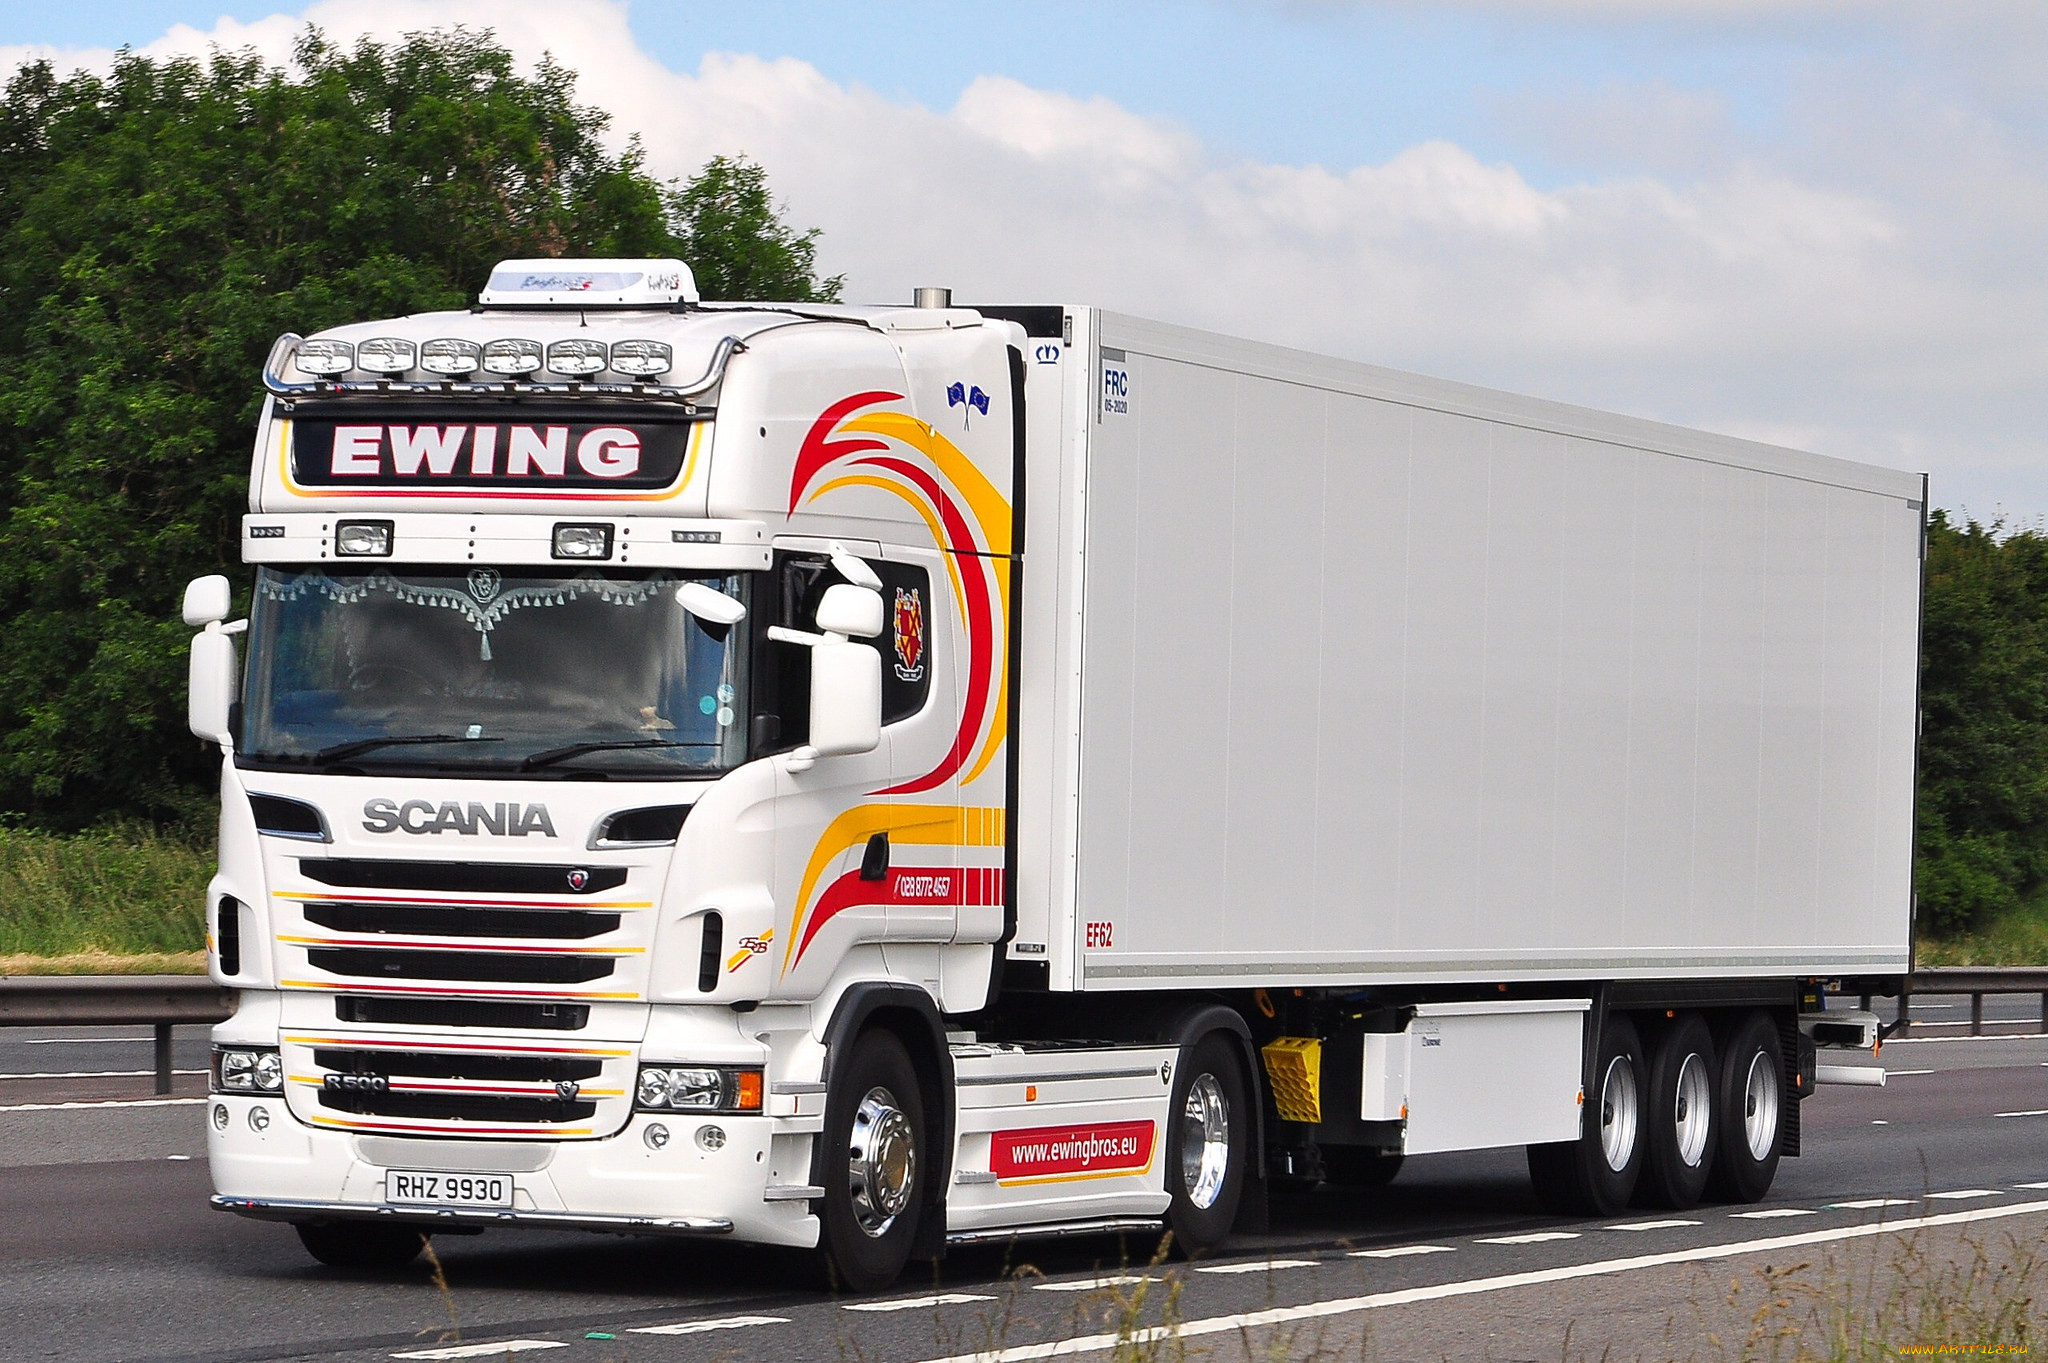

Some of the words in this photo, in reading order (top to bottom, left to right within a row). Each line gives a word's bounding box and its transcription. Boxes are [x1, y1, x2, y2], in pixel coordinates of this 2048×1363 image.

[1105, 369, 1128, 397] FRC
[331, 424, 641, 478] EWING
[362, 798, 558, 838] SCANIA
[901, 875, 915, 897] 028
[915, 876, 933, 897] 8772
[1086, 921, 1113, 948] EF62
[1012, 1133, 1138, 1167] www.ewingbros.eu
[396, 1175, 439, 1199] RHZ
[445, 1178, 502, 1201] 9930
